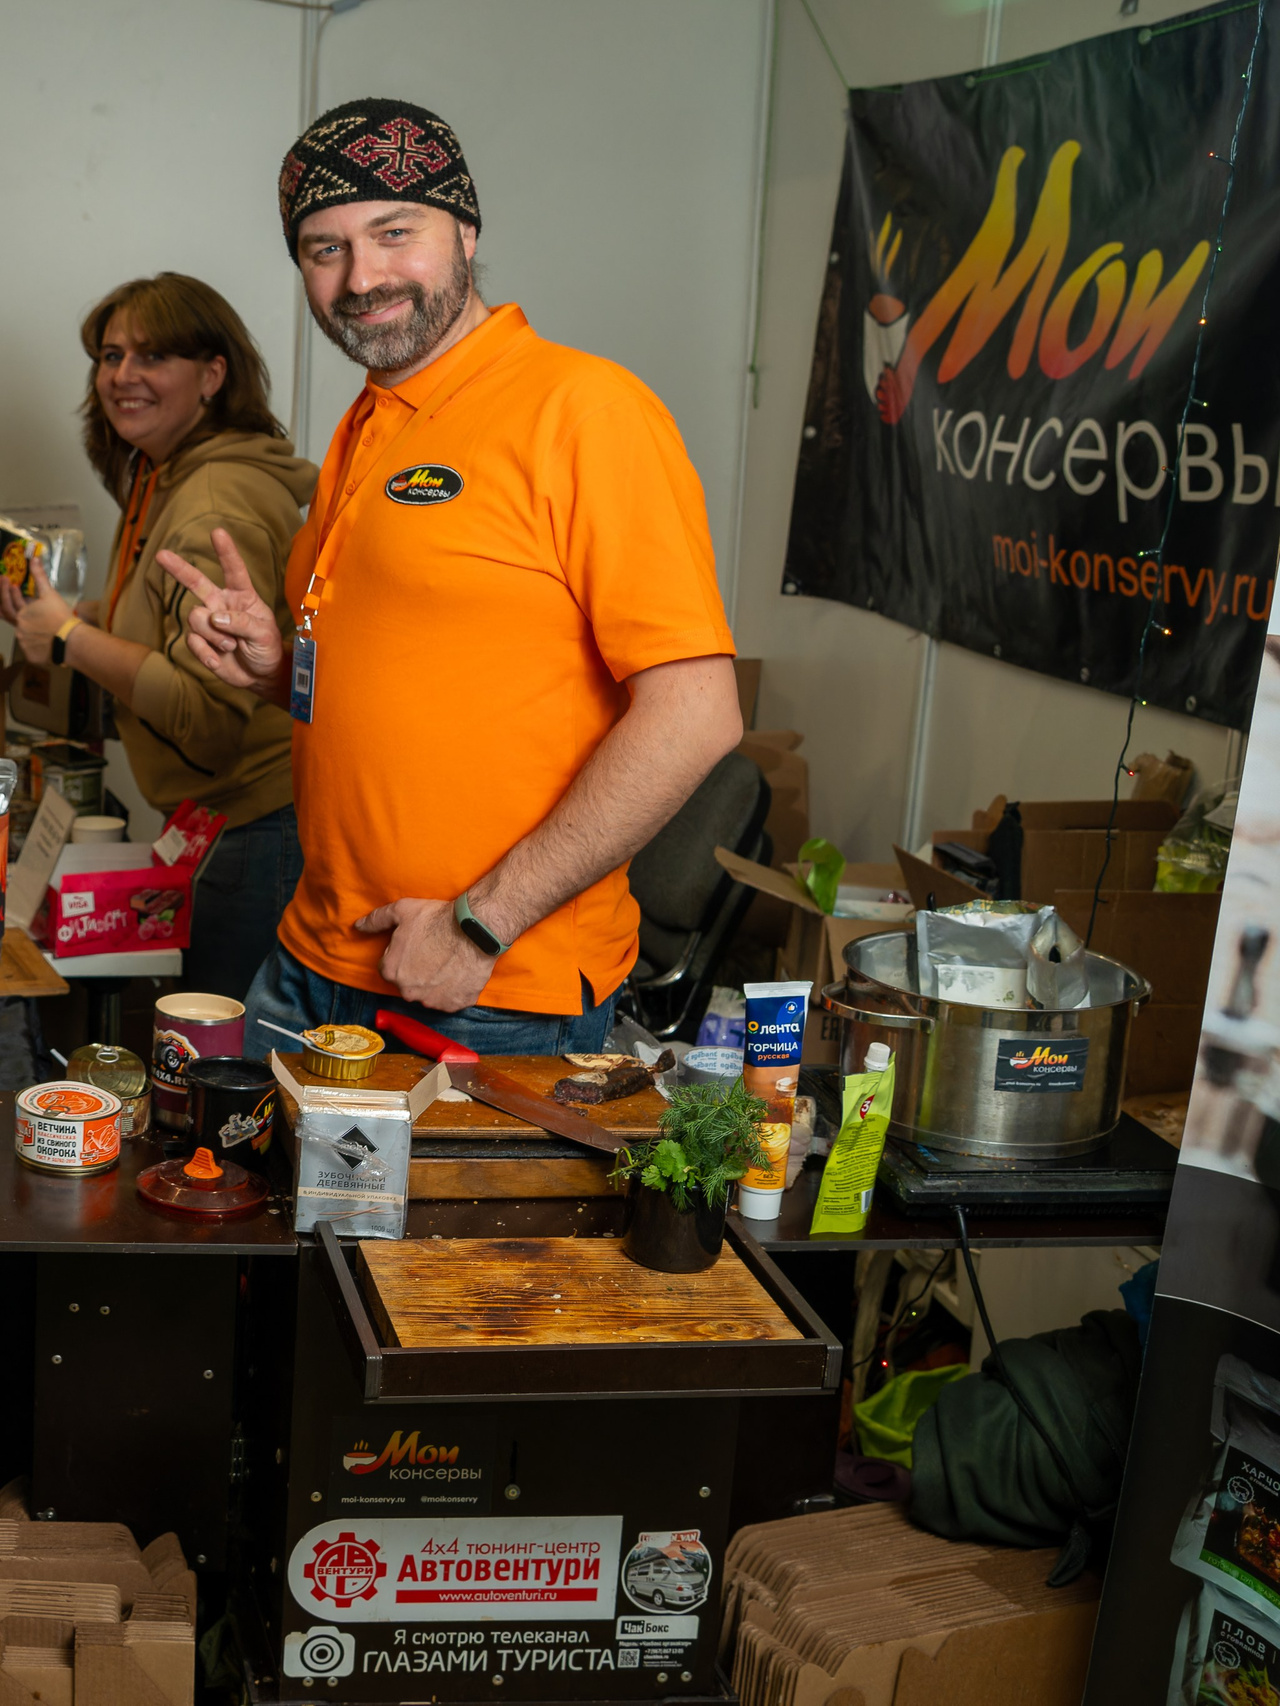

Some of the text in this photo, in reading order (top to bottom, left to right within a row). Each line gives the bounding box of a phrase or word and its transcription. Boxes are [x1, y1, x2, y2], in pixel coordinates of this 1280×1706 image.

[895, 139, 1211, 385] Мои
[993, 532, 1273, 626] moi-konservy.ru
[759, 1021, 800, 1035] лента
[747, 1041, 799, 1053] ГОРЧИЦА
[757, 1053, 790, 1061] русская
[1027, 1046, 1069, 1066] Мои
[37, 1121, 77, 1134] ВЕТЧИНА
[37, 1137, 77, 1148] ИЗ СВИНОГО
[37, 1145, 77, 1157] ОКОРОКА
[316, 1179, 386, 1191] ДЕРЕВЯННЫЕ
[308, 1190, 366, 1199] ИНДИВИДУАЛЬНОЙ
[368, 1430, 460, 1467] Мои
[389, 1468, 482, 1482] консервы
[1241, 1461, 1280, 1491] ХАРЧО
[341, 1495, 406, 1505] moi-konservy.ru
[466, 1539, 601, 1558] тюнинг-центр
[317, 1566, 374, 1576] ВЕНТУРИ
[396, 1554, 600, 1588] Автовентури
[438, 1589, 558, 1602] www.autoventuri.ru
[393, 1630, 589, 1647] Я смотрю телеканал
[1222, 1620, 1266, 1654] ПЛОВ
[363, 1649, 615, 1673] ГЛАЗАМИ ТУРИСТА
